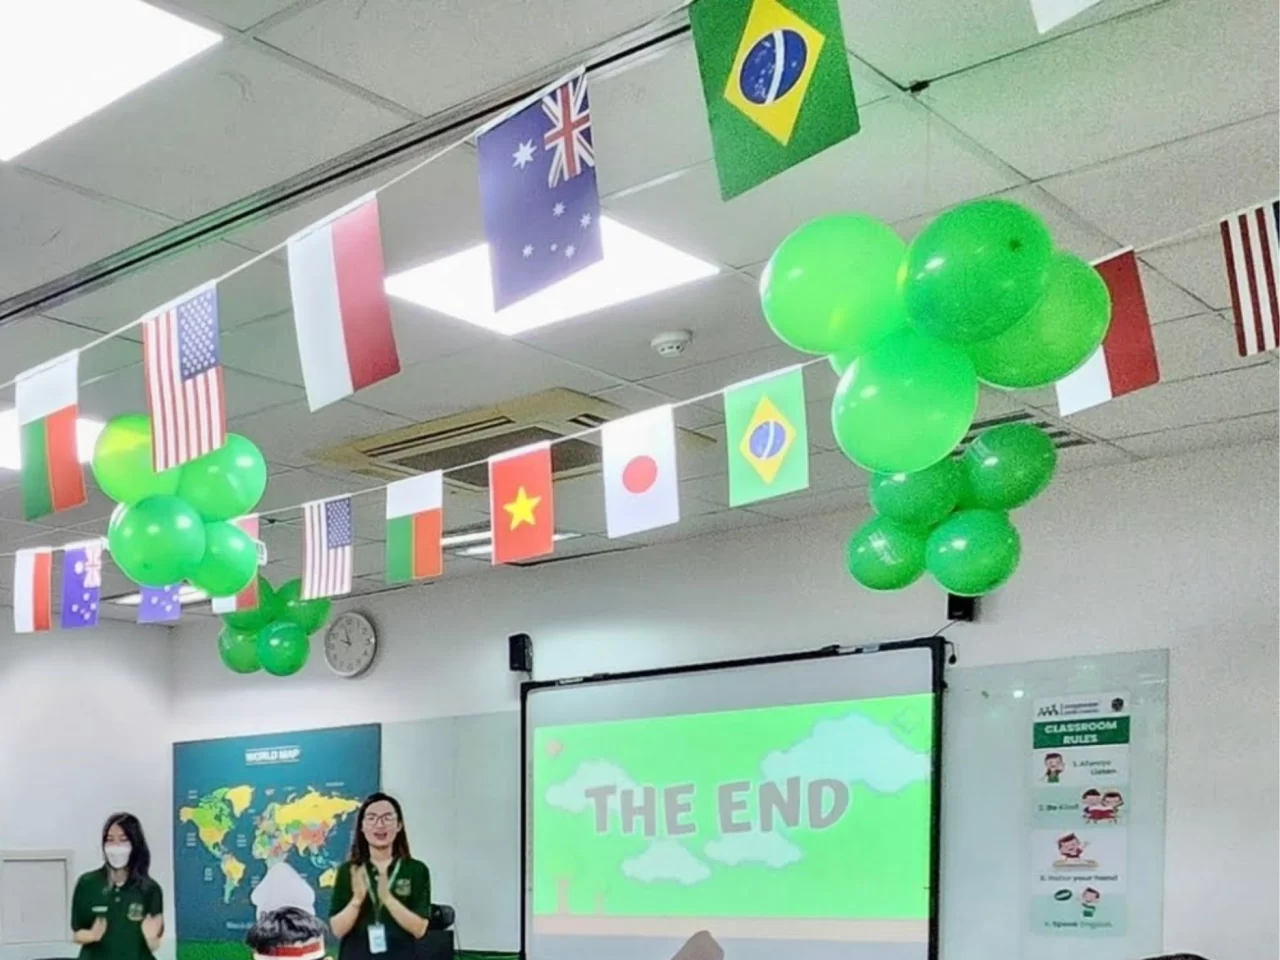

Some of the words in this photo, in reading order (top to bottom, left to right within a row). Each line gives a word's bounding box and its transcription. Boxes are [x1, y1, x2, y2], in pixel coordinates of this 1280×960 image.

[1044, 720, 1118, 734] CLASSROOM
[1063, 734, 1098, 745] RULES
[246, 751, 278, 762] WORLD
[279, 748, 300, 760] MAP
[584, 784, 696, 837] THE
[718, 776, 849, 834] END
